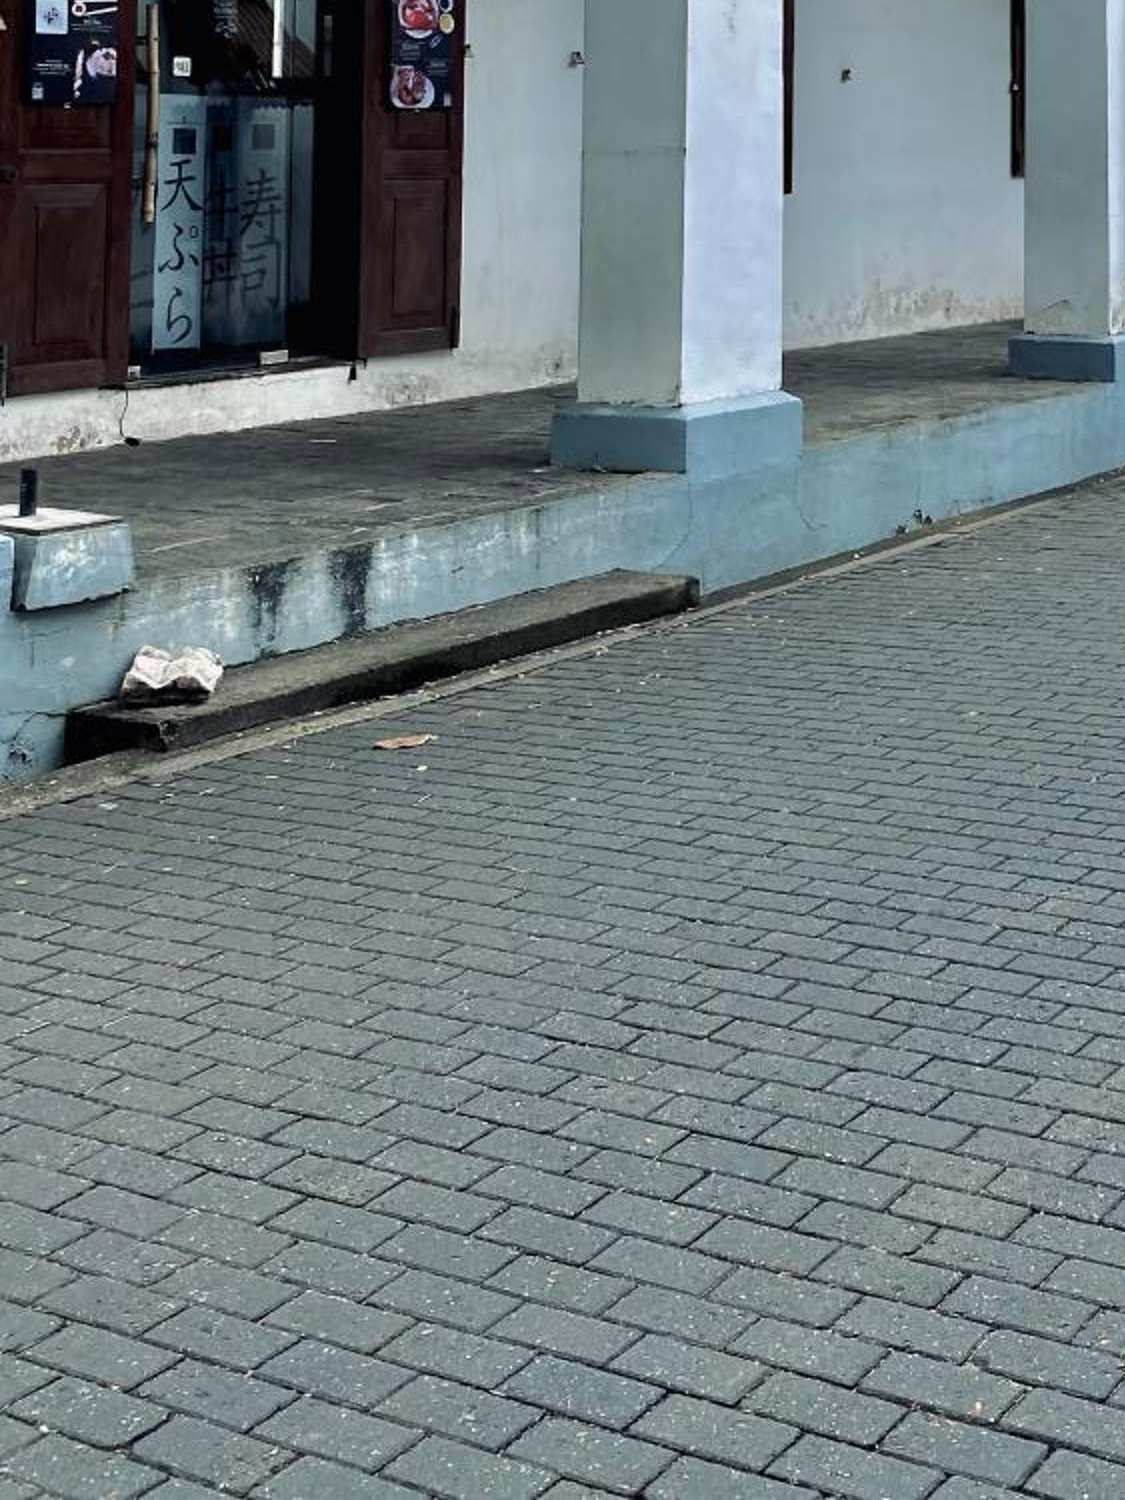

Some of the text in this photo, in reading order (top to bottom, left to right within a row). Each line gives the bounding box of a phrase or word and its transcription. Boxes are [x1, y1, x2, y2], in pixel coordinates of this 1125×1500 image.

[158, 159, 203, 344] 天ぷら
[240, 167, 282, 309] 寿司
